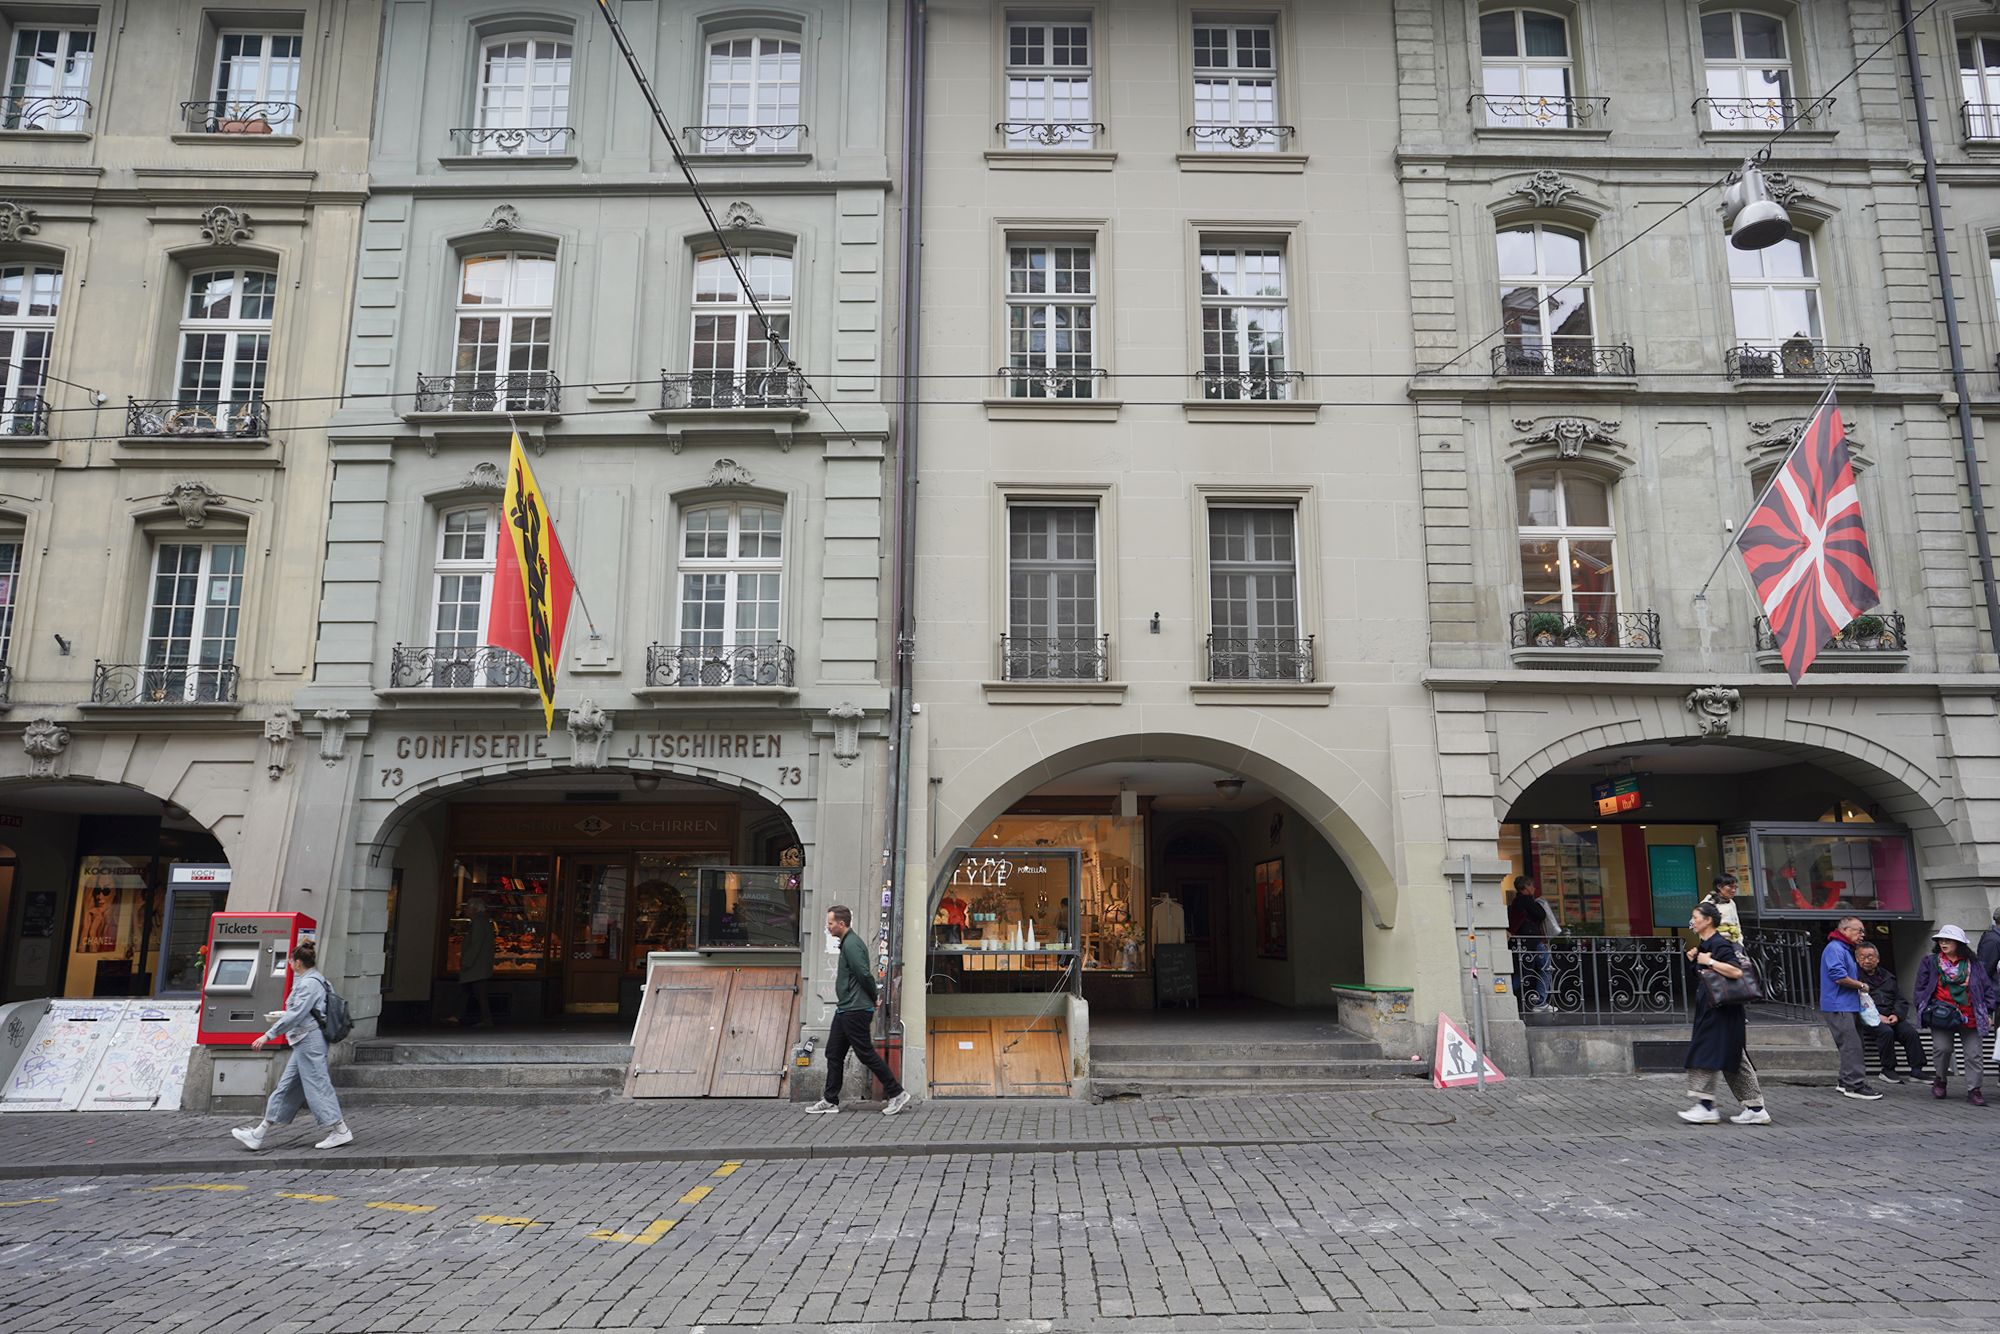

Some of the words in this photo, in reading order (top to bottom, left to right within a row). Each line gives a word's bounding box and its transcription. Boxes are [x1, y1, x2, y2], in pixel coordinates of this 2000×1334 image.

[397, 734, 548, 759] CONFISERIE
[381, 767, 403, 787] 73
[778, 766, 802, 785] 73
[84, 866, 116, 876] KOCH
[191, 869, 216, 877] KOCH
[217, 922, 258, 935] Tickets
[82, 936, 113, 946] CHANEL
